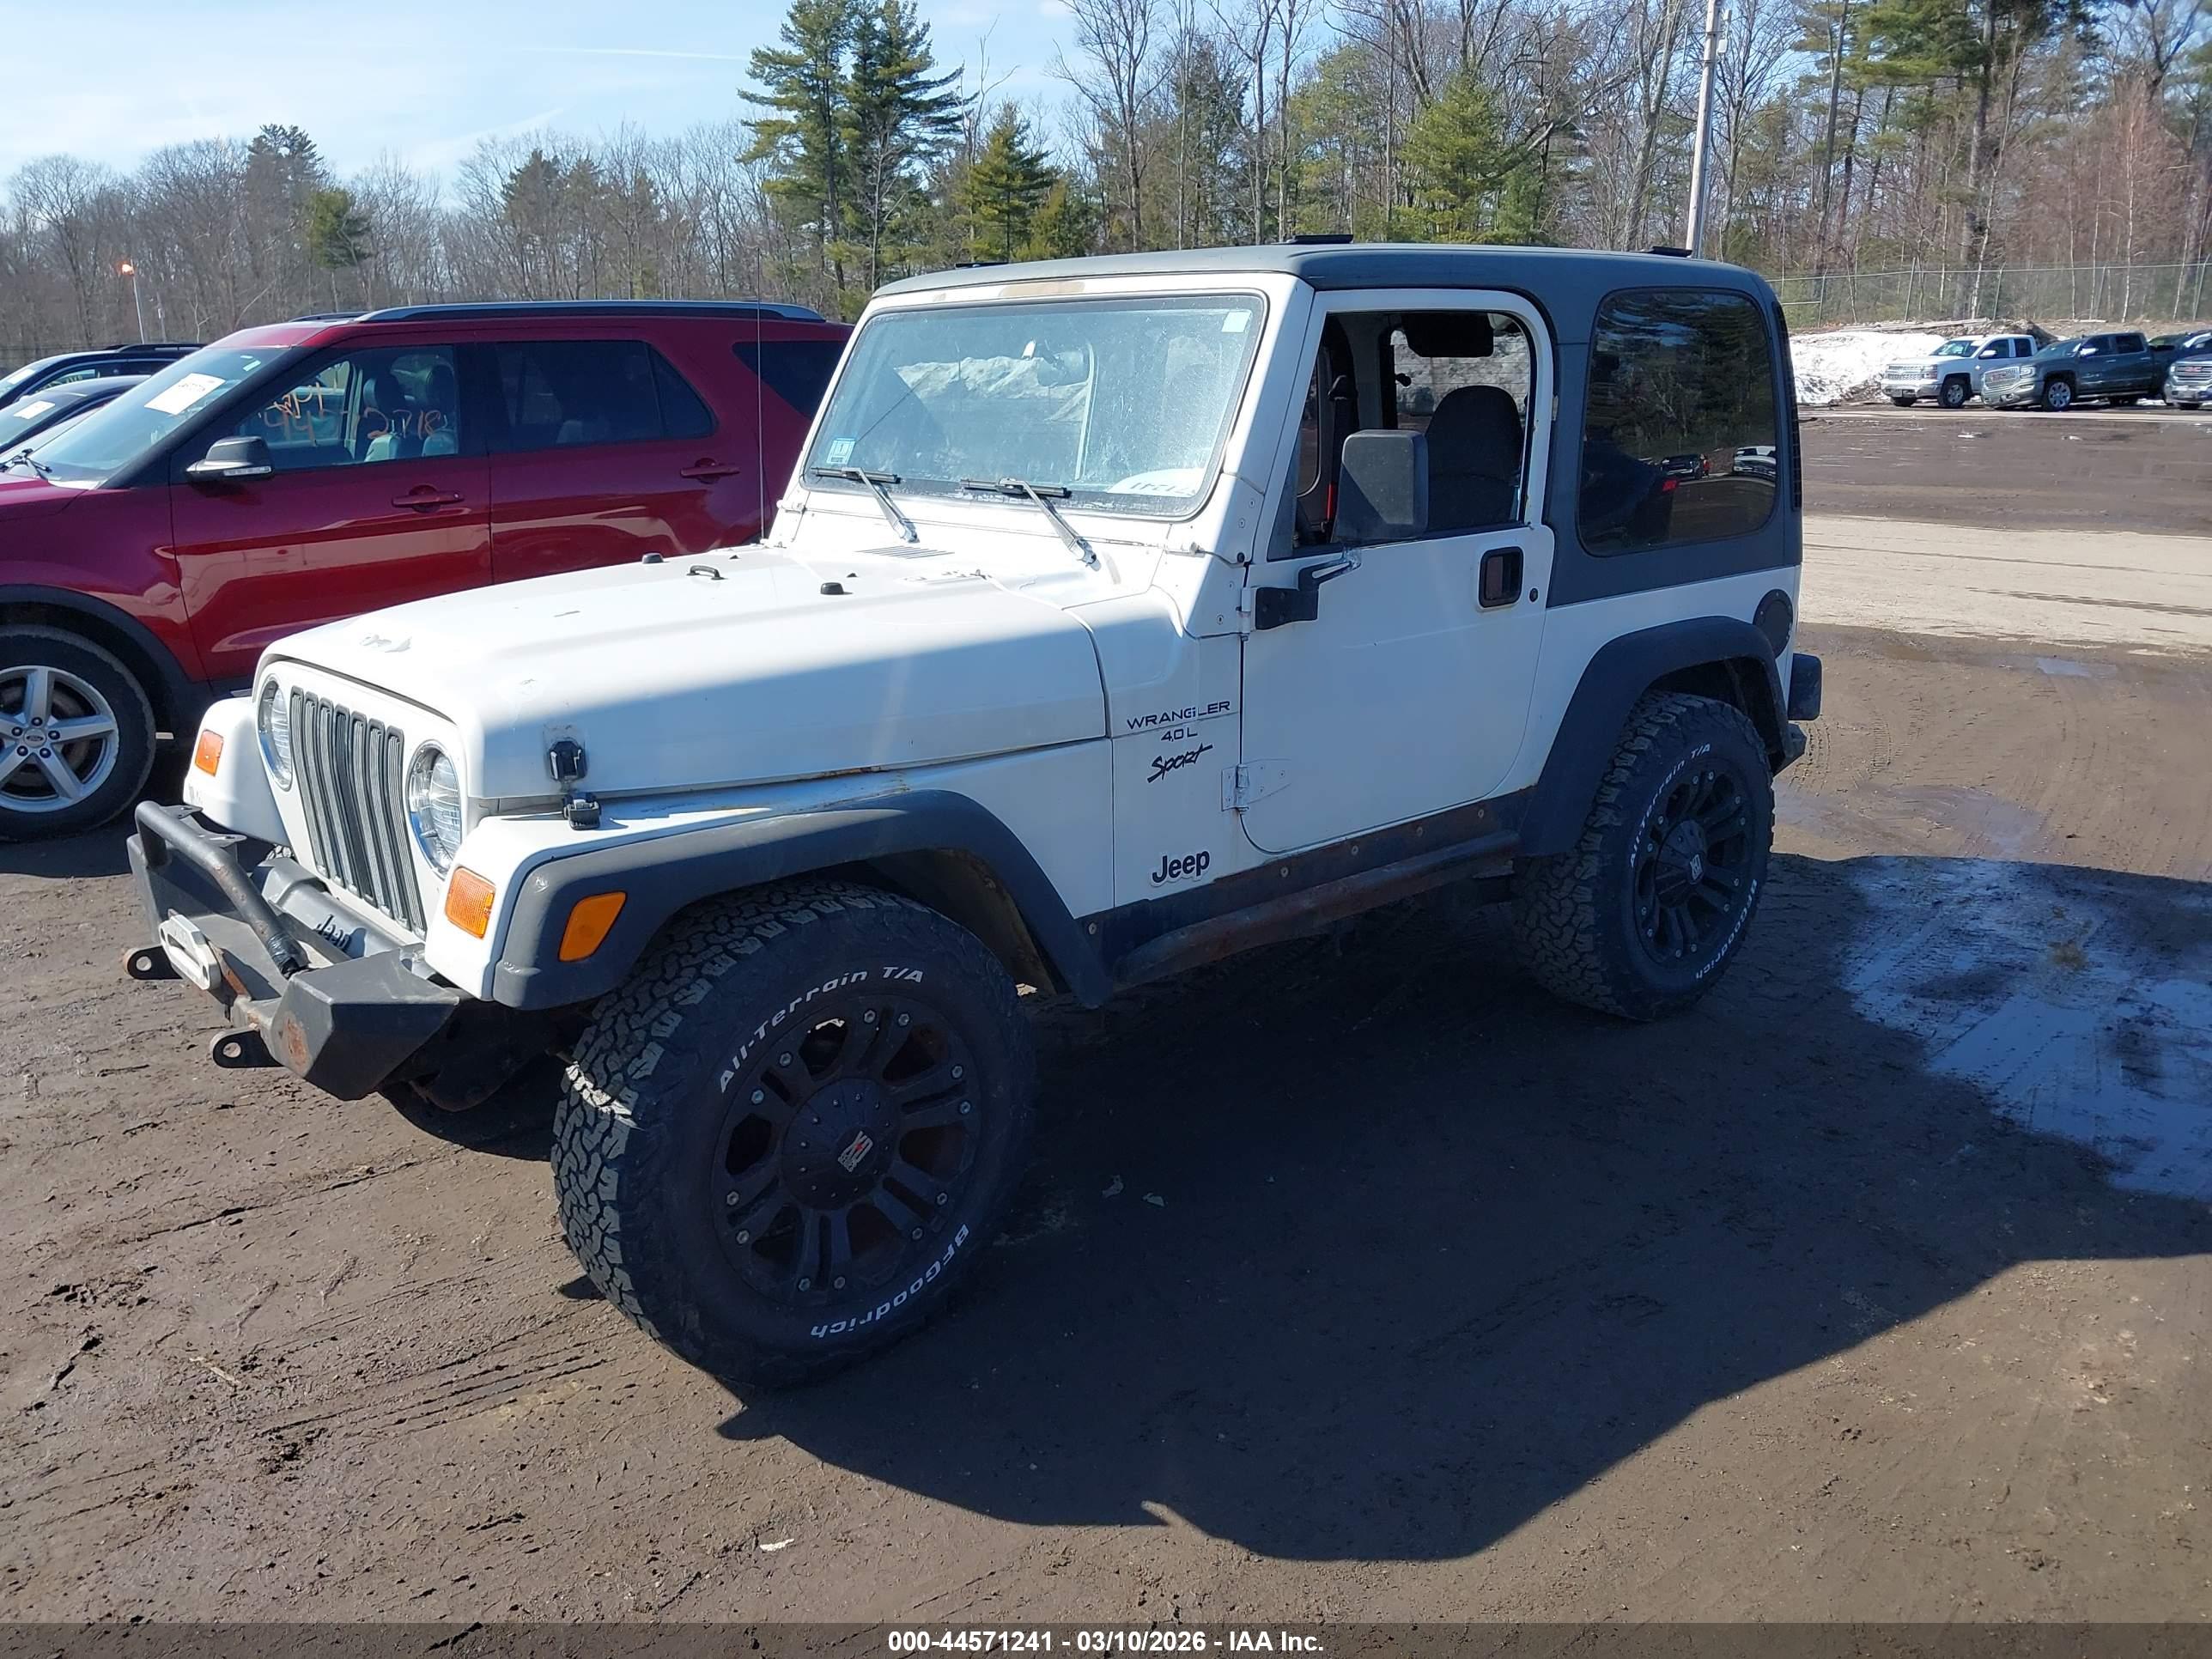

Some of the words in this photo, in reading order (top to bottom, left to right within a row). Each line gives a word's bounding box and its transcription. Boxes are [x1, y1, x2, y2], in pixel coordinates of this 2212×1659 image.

[1127, 701, 1231, 730] WRANGLER
[1147, 743, 1213, 783] Sport
[1152, 850, 1210, 884] Jeep
[720, 969, 868, 1093] All-Terrain
[882, 966, 924, 983] T/A
[810, 1224, 969, 1339] BFGoodrich
